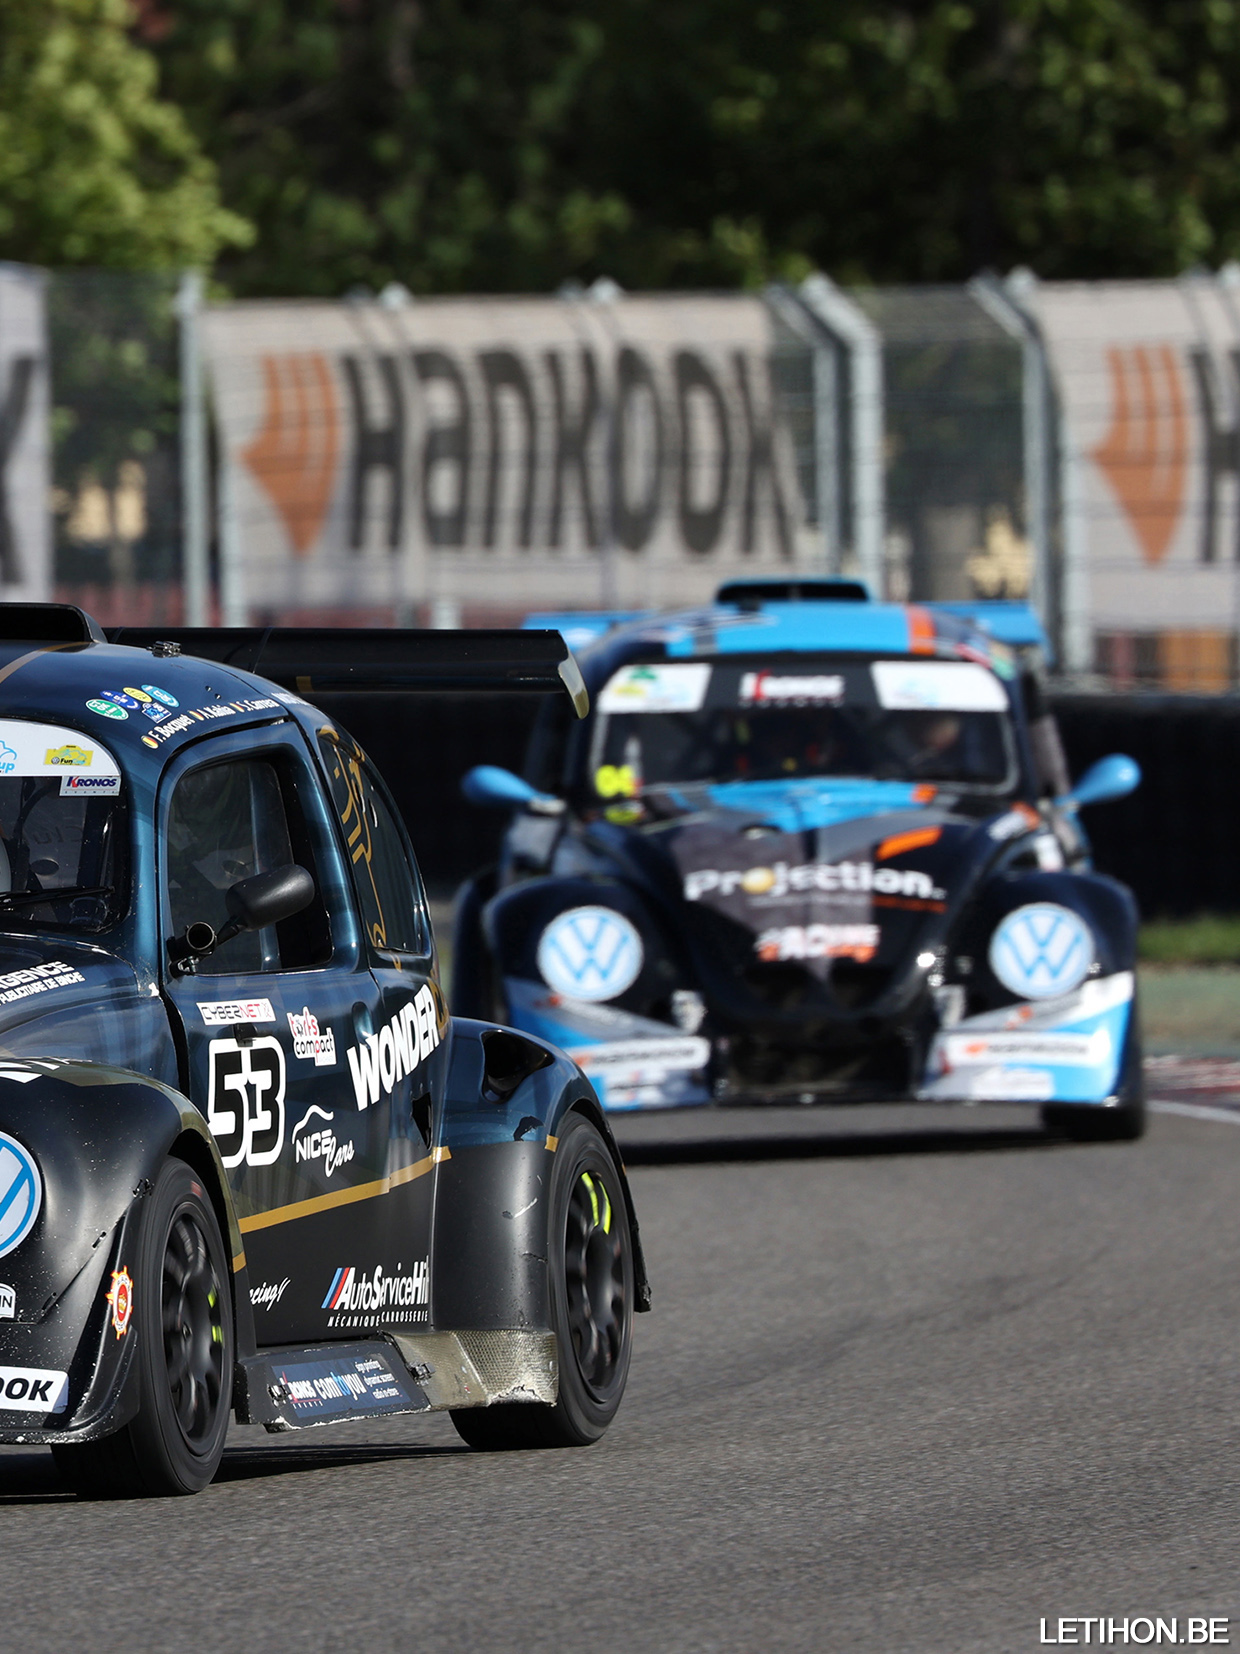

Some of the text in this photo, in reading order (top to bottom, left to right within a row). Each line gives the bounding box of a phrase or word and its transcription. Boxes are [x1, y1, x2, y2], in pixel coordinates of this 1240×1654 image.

[66, 776, 117, 788] KRONOS
[44, 976, 60, 989] DE
[347, 984, 440, 1111] WONDER
[208, 1036, 287, 1168] 53
[296, 1129, 333, 1163] NICE
[325, 1136, 355, 1177] Cars
[327, 1311, 428, 1328] MÉCANIQUE CARROSSERIE
